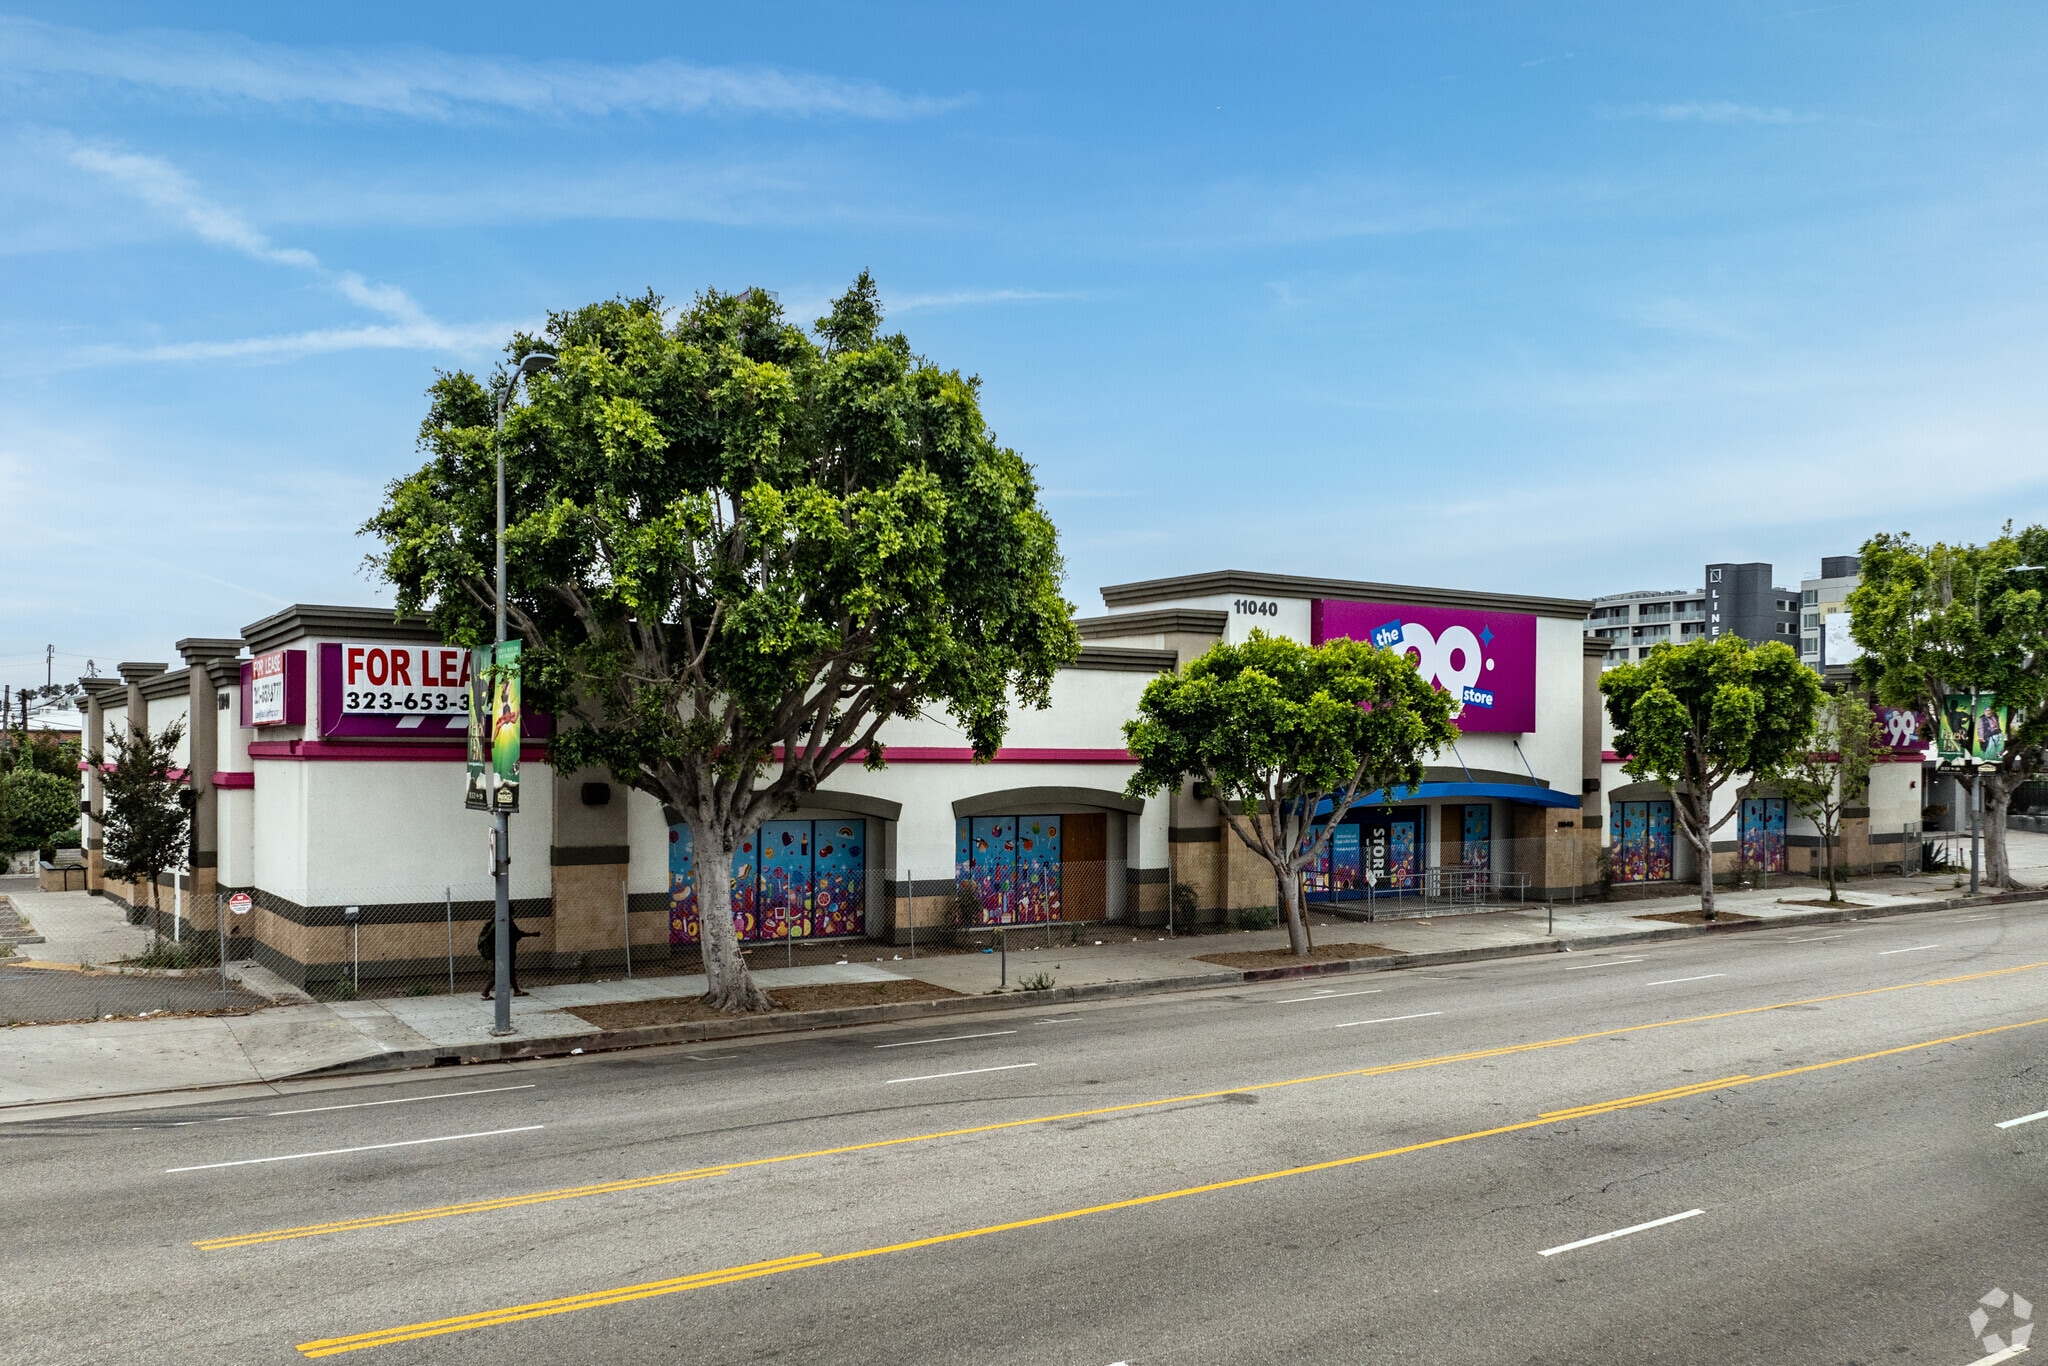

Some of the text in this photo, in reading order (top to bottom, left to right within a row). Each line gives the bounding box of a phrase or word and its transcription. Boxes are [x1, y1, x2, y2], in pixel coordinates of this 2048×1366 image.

[1234, 599, 1278, 617] 11040
[1711, 589, 1720, 645] LINE
[1376, 627, 1399, 647] the
[253, 655, 280, 677] FOR LEASE
[347, 647, 484, 687] FOR LEA
[346, 691, 482, 711] 323-653-3
[1463, 689, 1494, 706] store
[1888, 710, 1915, 746] 99
[1373, 828, 1386, 878] STORE
